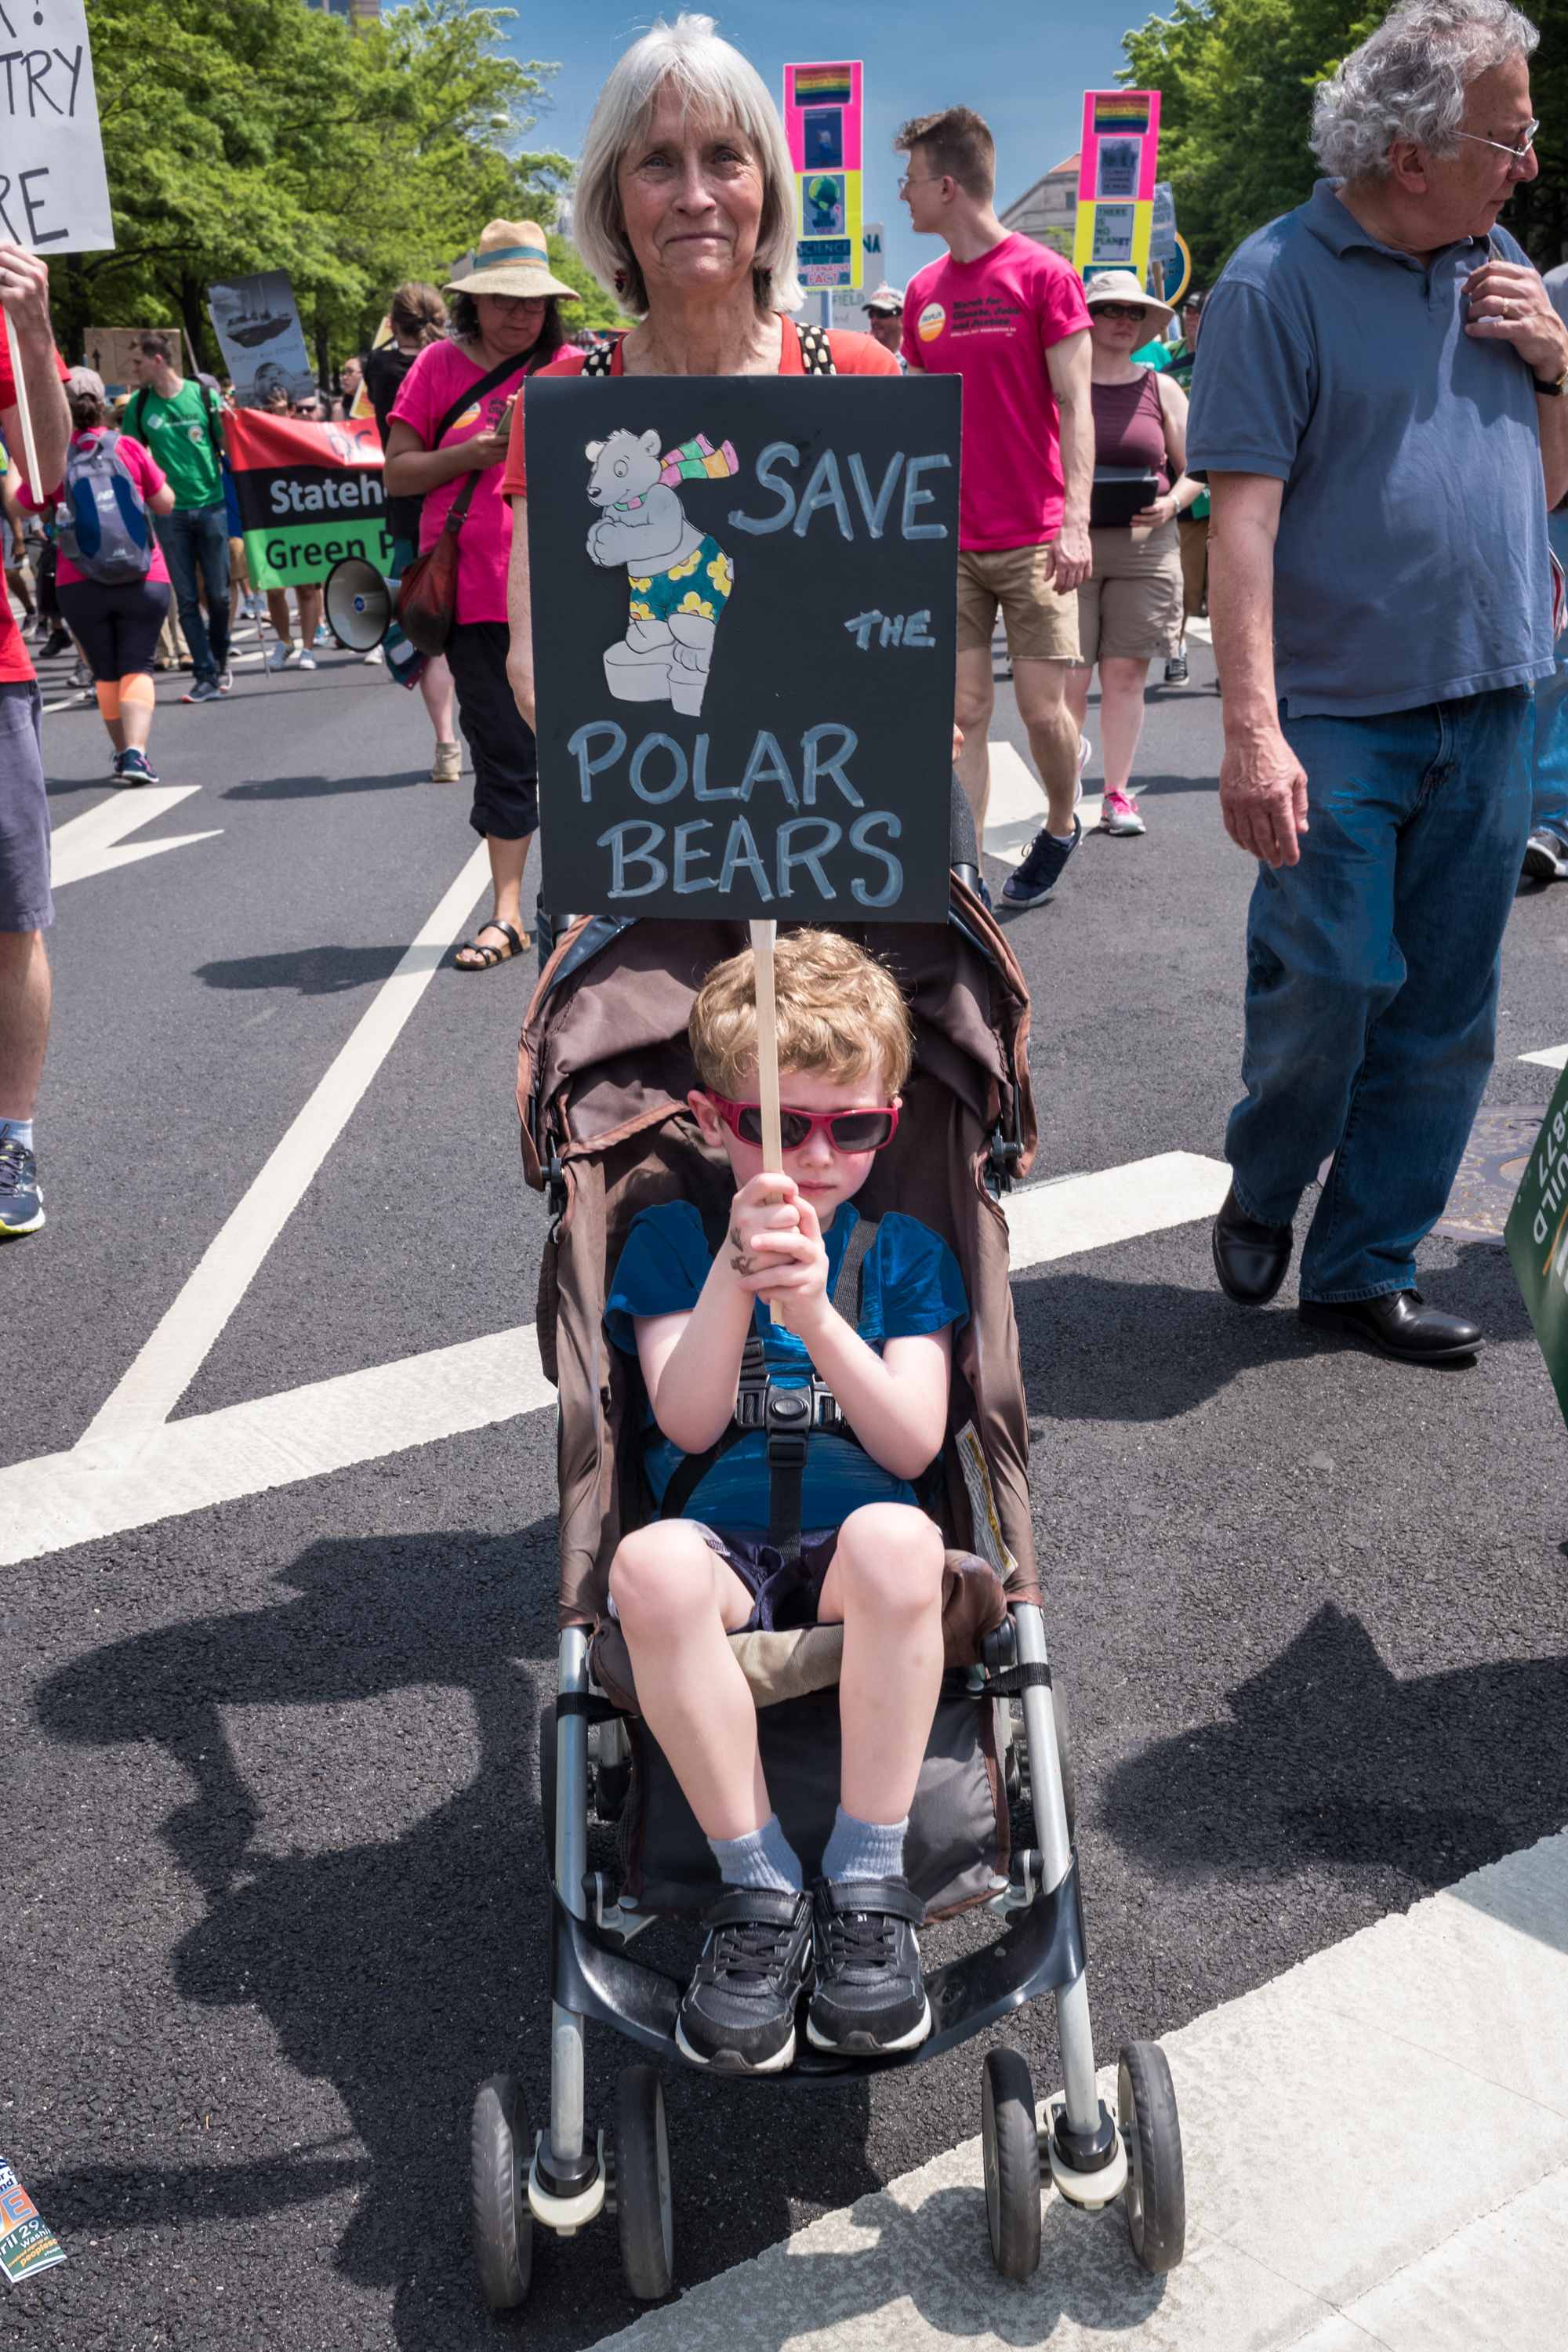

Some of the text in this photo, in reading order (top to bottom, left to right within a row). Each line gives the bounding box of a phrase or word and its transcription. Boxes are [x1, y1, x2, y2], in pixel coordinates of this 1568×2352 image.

[797, 241, 849, 256] SCIENCE
[808, 274, 838, 285] FACT
[833, 293, 866, 307] FIELD
[953, 296, 1003, 310] March for
[952, 317, 1011, 330] and Justice
[327, 430, 377, 458] DC
[270, 474, 387, 514] Stateh
[728, 441, 953, 541] SAVE
[266, 538, 366, 570] Green
[844, 609, 936, 651] THE
[567, 720, 865, 808] POLAR
[597, 810, 904, 907] BEARS
